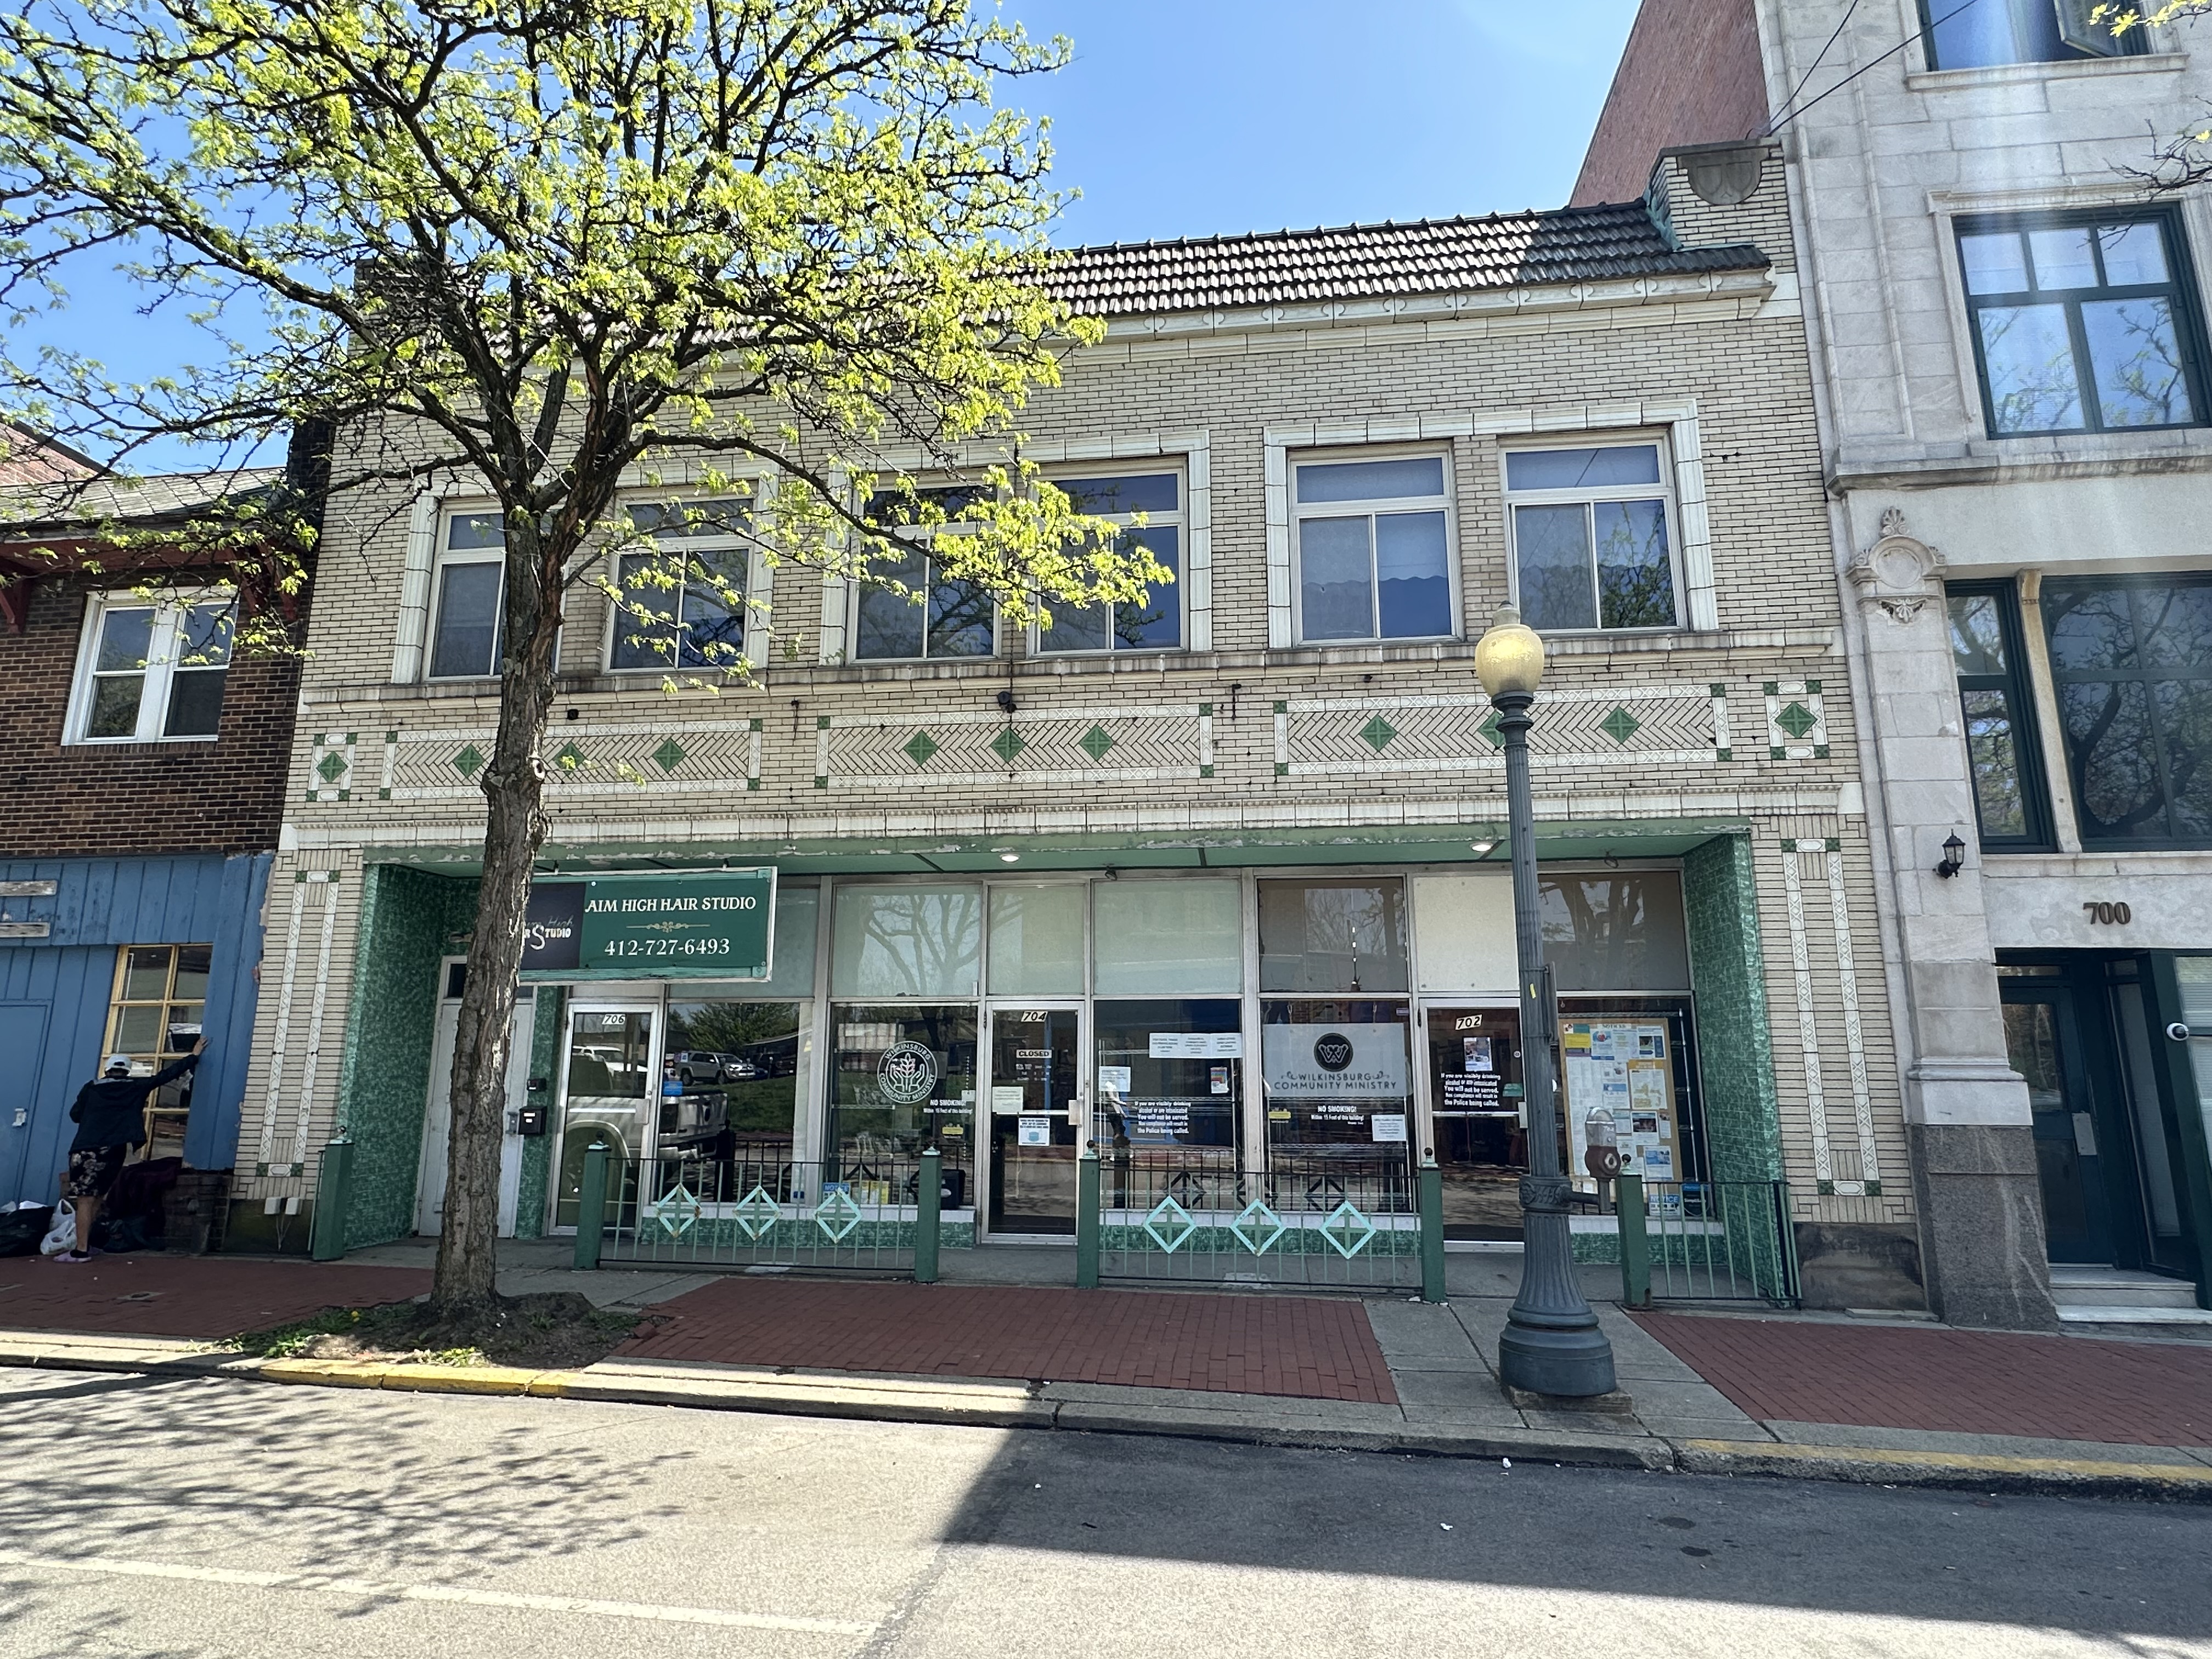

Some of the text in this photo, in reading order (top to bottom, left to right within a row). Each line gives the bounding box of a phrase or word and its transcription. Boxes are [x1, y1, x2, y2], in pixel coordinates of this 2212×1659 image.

[585, 896, 757, 912] AIM HIGH HAIR STUDIO
[2083, 902, 2131, 925] 700
[604, 938, 730, 956] 412-727-6493
[604, 1015, 625, 1024] 706
[1023, 1012, 1047, 1021] 704
[1457, 1016, 1480, 1029] 702
[1298, 1073, 1372, 1081] WILKINSBURG
[879, 1073, 935, 1102] COMMUNITY MINISTRY
[1274, 1081, 1396, 1090] COMMUNITY MINISTRY
